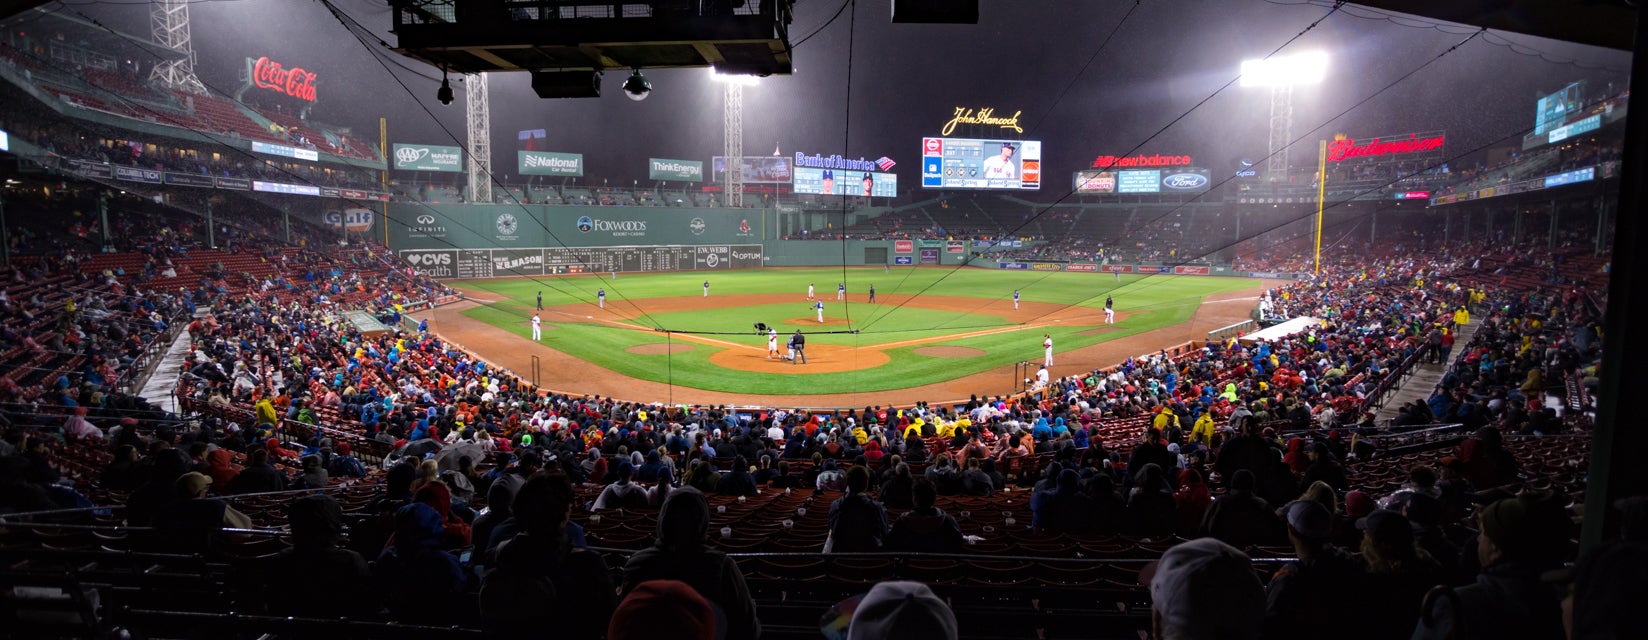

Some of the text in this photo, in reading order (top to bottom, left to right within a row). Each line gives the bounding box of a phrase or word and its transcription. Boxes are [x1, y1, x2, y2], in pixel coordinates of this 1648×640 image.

[942, 106, 1023, 136] John Hancock
[1328, 133, 1446, 162] Budweiser
[537, 156, 578, 167] National
[795, 152, 875, 171] Bank of America
[143, 170, 159, 180] TECH
[1171, 175, 1198, 187] Ford
[326, 212, 370, 223] Gulf
[594, 220, 647, 231] FOXWOODS
[422, 254, 451, 265] CVS
